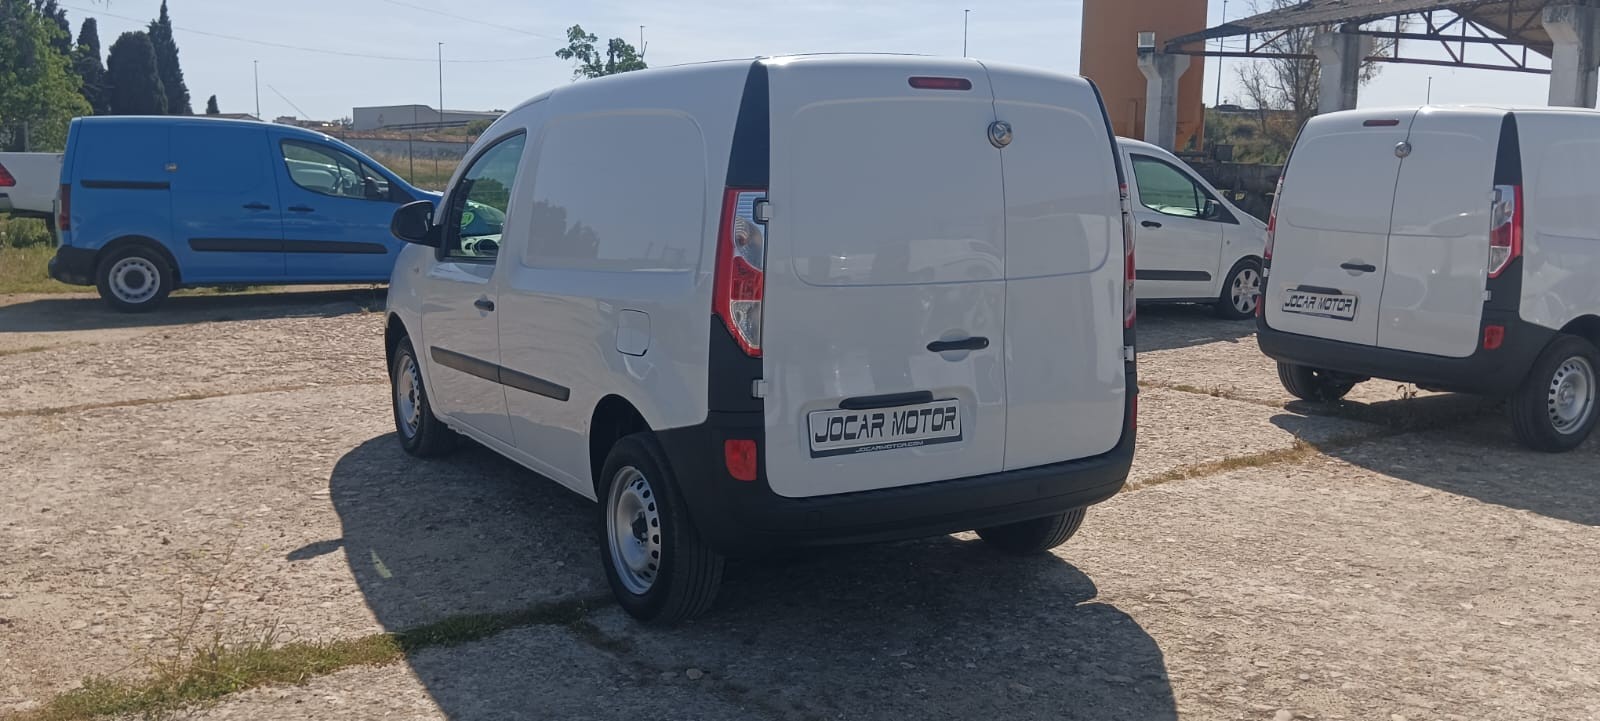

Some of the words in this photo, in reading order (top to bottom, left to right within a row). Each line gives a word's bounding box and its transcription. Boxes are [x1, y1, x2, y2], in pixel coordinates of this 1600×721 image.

[1285, 295, 1317, 309] JOCAR
[1317, 296, 1352, 312] MOTOR
[815, 413, 885, 443] JOCAR
[891, 406, 957, 436] MOTOR
